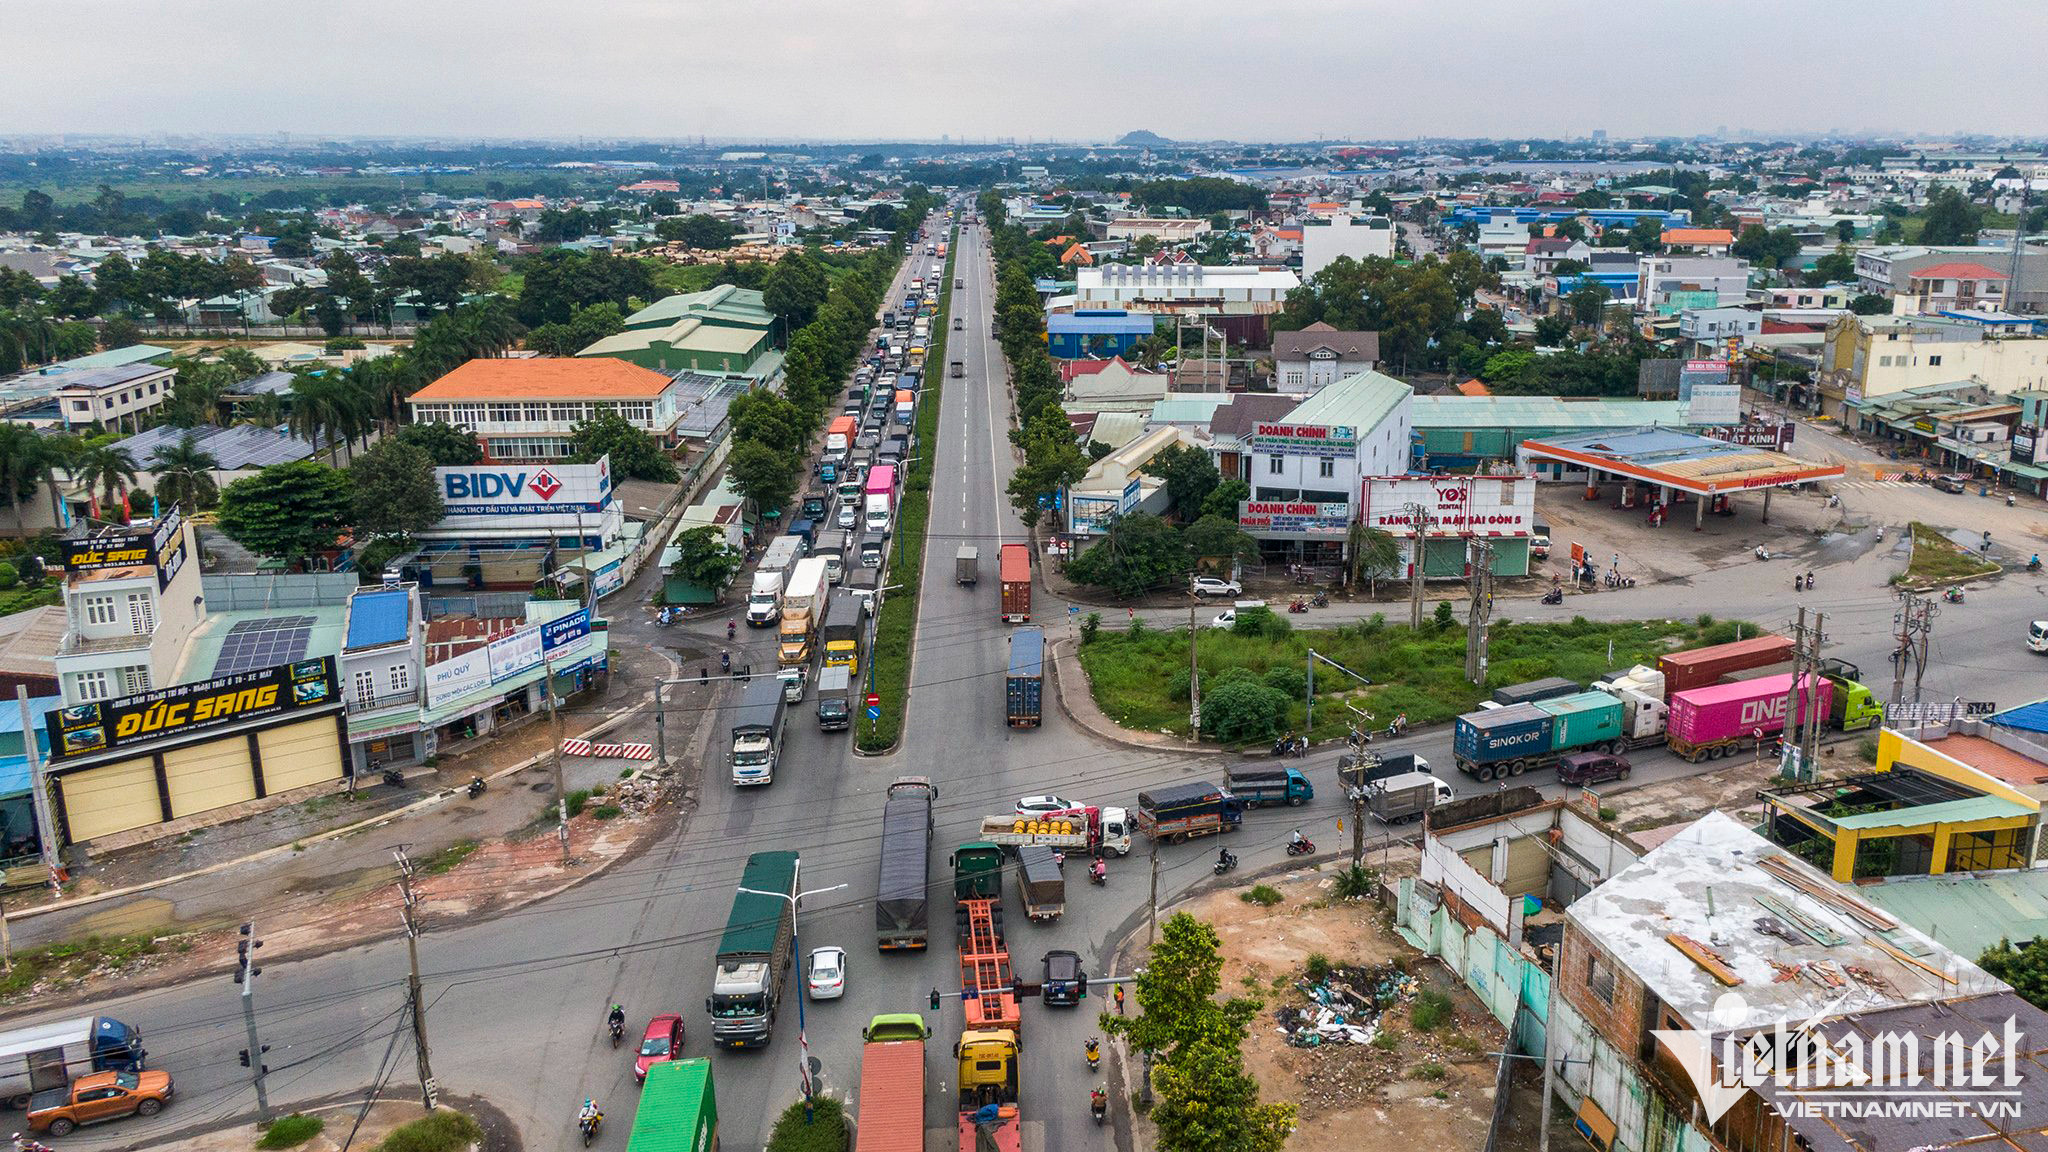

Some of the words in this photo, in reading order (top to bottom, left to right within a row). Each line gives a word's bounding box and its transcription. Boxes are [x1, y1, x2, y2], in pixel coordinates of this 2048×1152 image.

[1259, 424, 1293, 437] DOANH
[1296, 425, 1326, 438] CHÍNH
[1749, 432, 1774, 443] KÍNH
[446, 473, 527, 498] BIDV
[1248, 504, 1284, 514] DOANH
[1286, 502, 1316, 514] CHÍNH
[1488, 514, 1513, 524] GÒN
[106, 549, 148, 562] SANG
[553, 615, 586, 634] PINACO
[192, 684, 279, 721] SANG
[1740, 696, 1788, 724] ONE
[1490, 731, 1539, 749] SINOKOR
